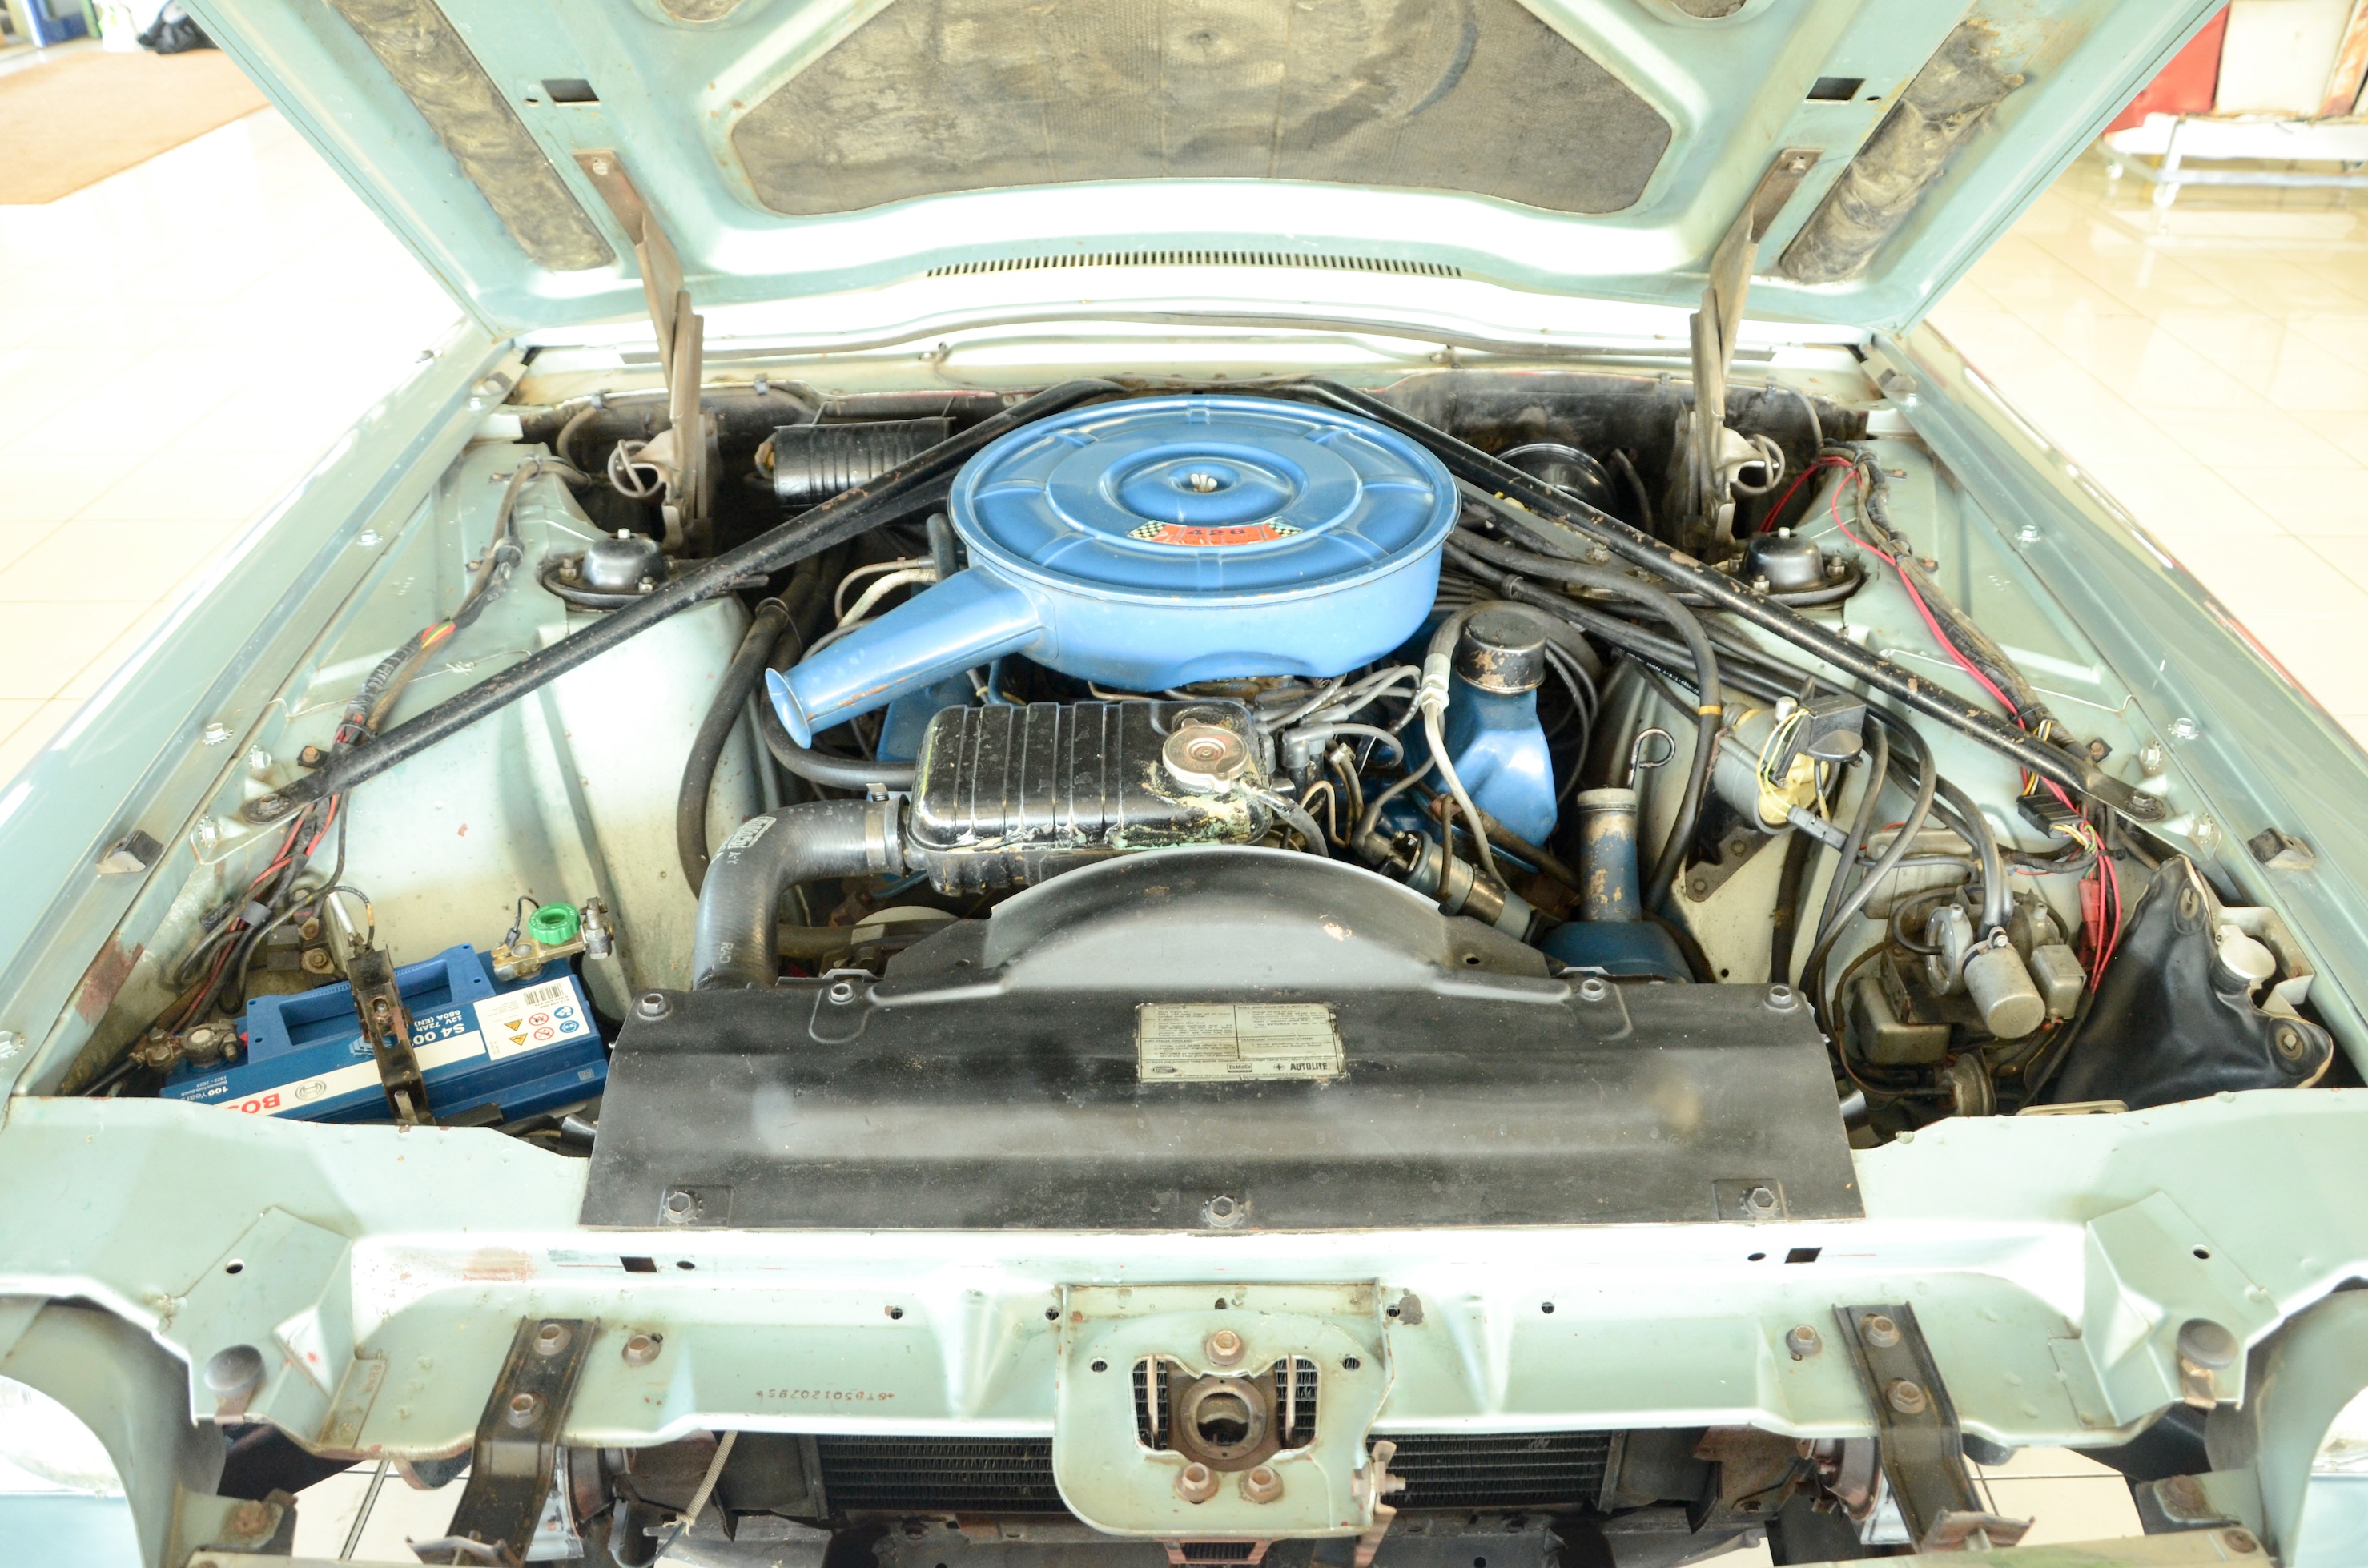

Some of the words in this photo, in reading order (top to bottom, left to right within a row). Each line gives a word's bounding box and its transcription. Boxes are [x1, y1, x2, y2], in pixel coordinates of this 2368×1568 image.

[436, 1010, 461, 1020] 680A
[445, 1015, 463, 1024] 12V
[414, 1016, 434, 1027] (EN)
[416, 1022, 440, 1031] 72Ah
[440, 1023, 465, 1037] S4
[412, 1031, 436, 1046] 00
[1289, 1063, 1329, 1071] AUTOLITE
[207, 1086, 229, 1096] 100
